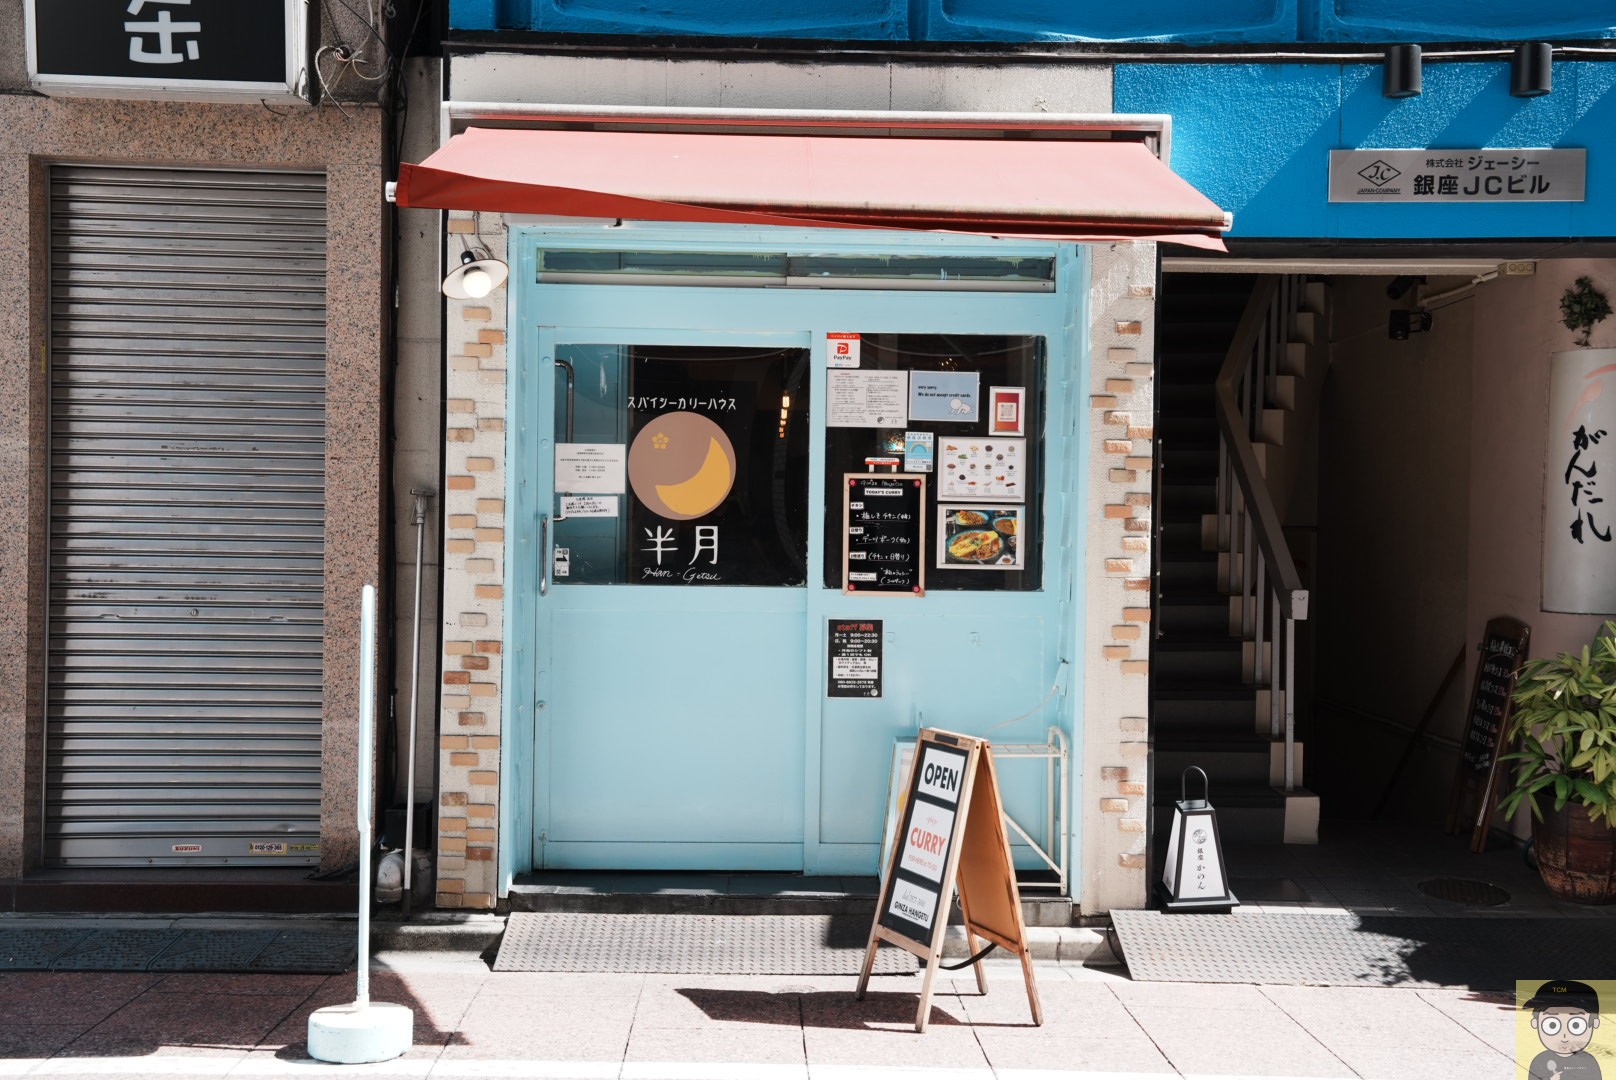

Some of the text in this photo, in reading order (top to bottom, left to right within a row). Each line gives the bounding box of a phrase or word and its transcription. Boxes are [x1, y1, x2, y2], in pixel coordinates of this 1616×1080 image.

[1425, 156, 1540, 171] 株式会社 ジェーシー
[1413, 174, 1550, 196] 銀座JCビル
[627, 396, 737, 411] スパイシーカリーハウス
[1565, 424, 1612, 545] がんだれ
[640, 525, 719, 566] 半月
[924, 762, 959, 792] OPEN
[910, 826, 946, 856] CURRY
[894, 901, 908, 913] GINZA
